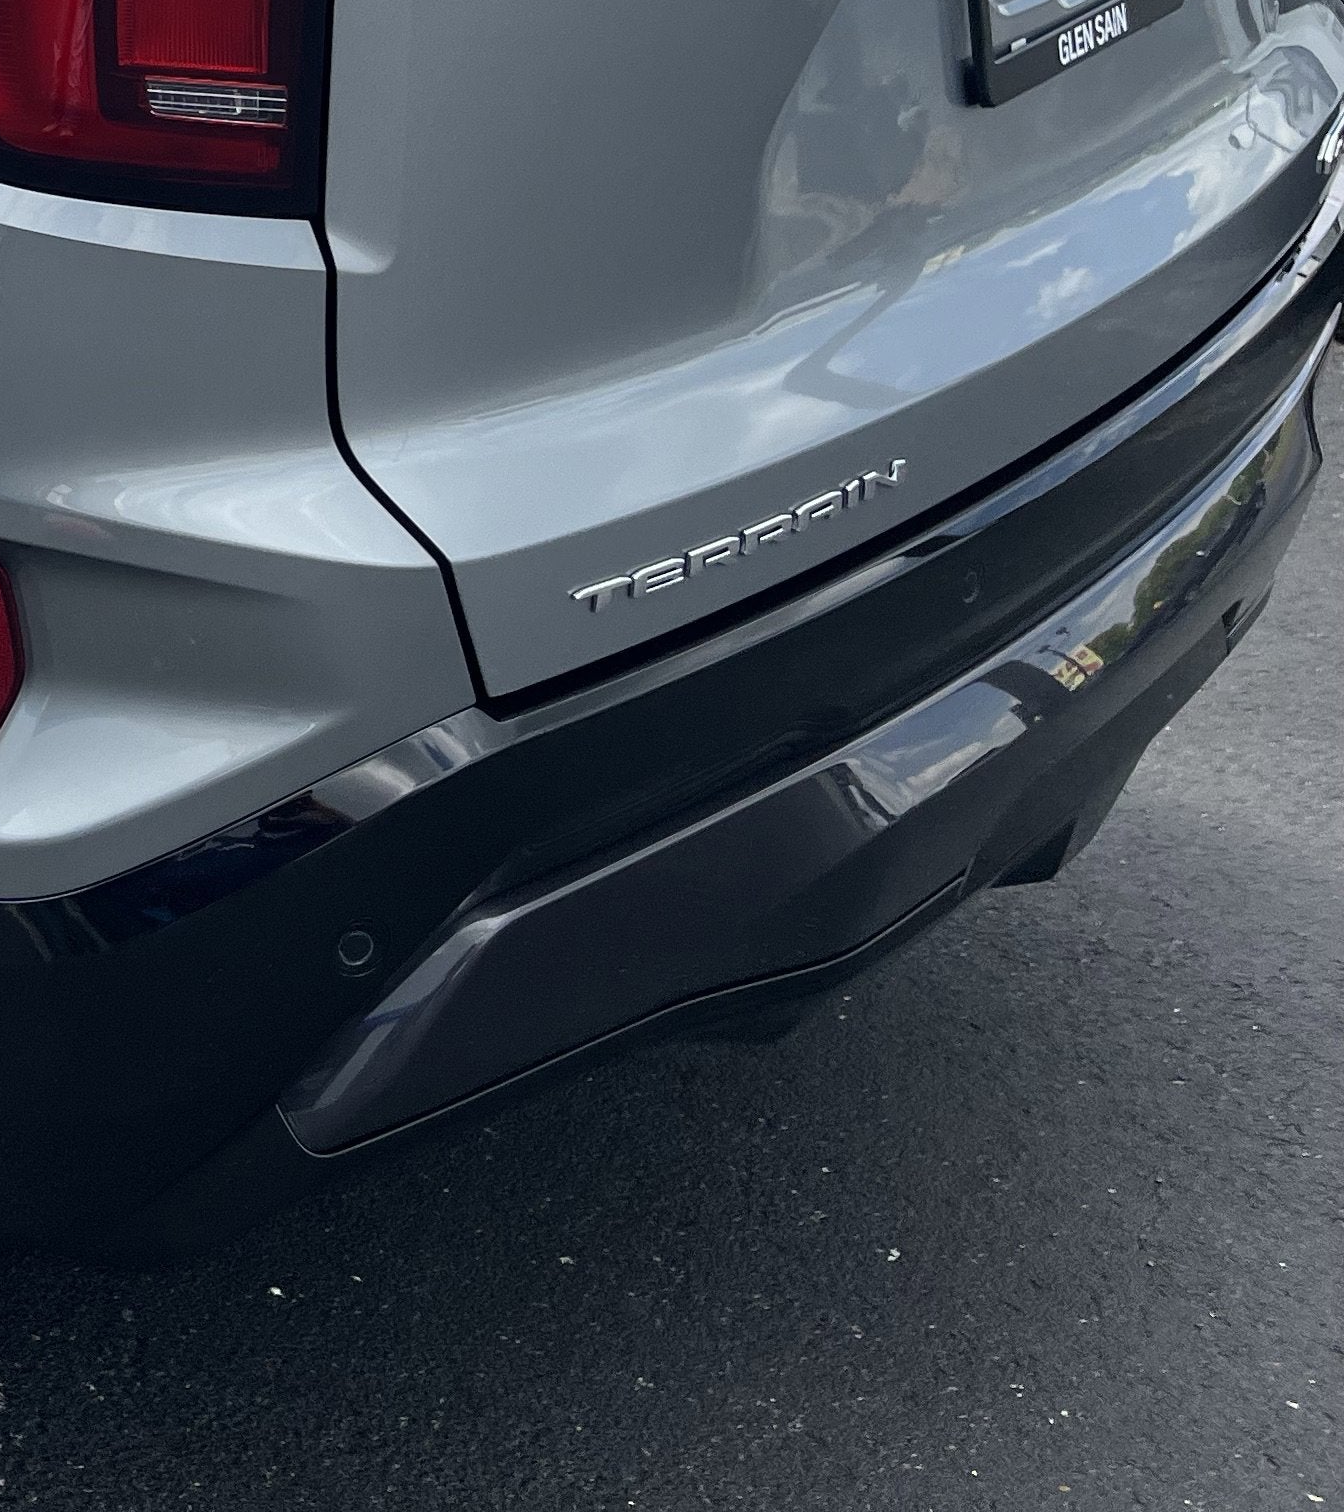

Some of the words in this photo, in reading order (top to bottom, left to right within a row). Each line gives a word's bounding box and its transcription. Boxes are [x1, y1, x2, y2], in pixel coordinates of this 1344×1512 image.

[1057, 20, 1095, 66] GLEN
[1093, 2, 1128, 46] SAIN
[568, 457, 907, 614] TERRAIN
